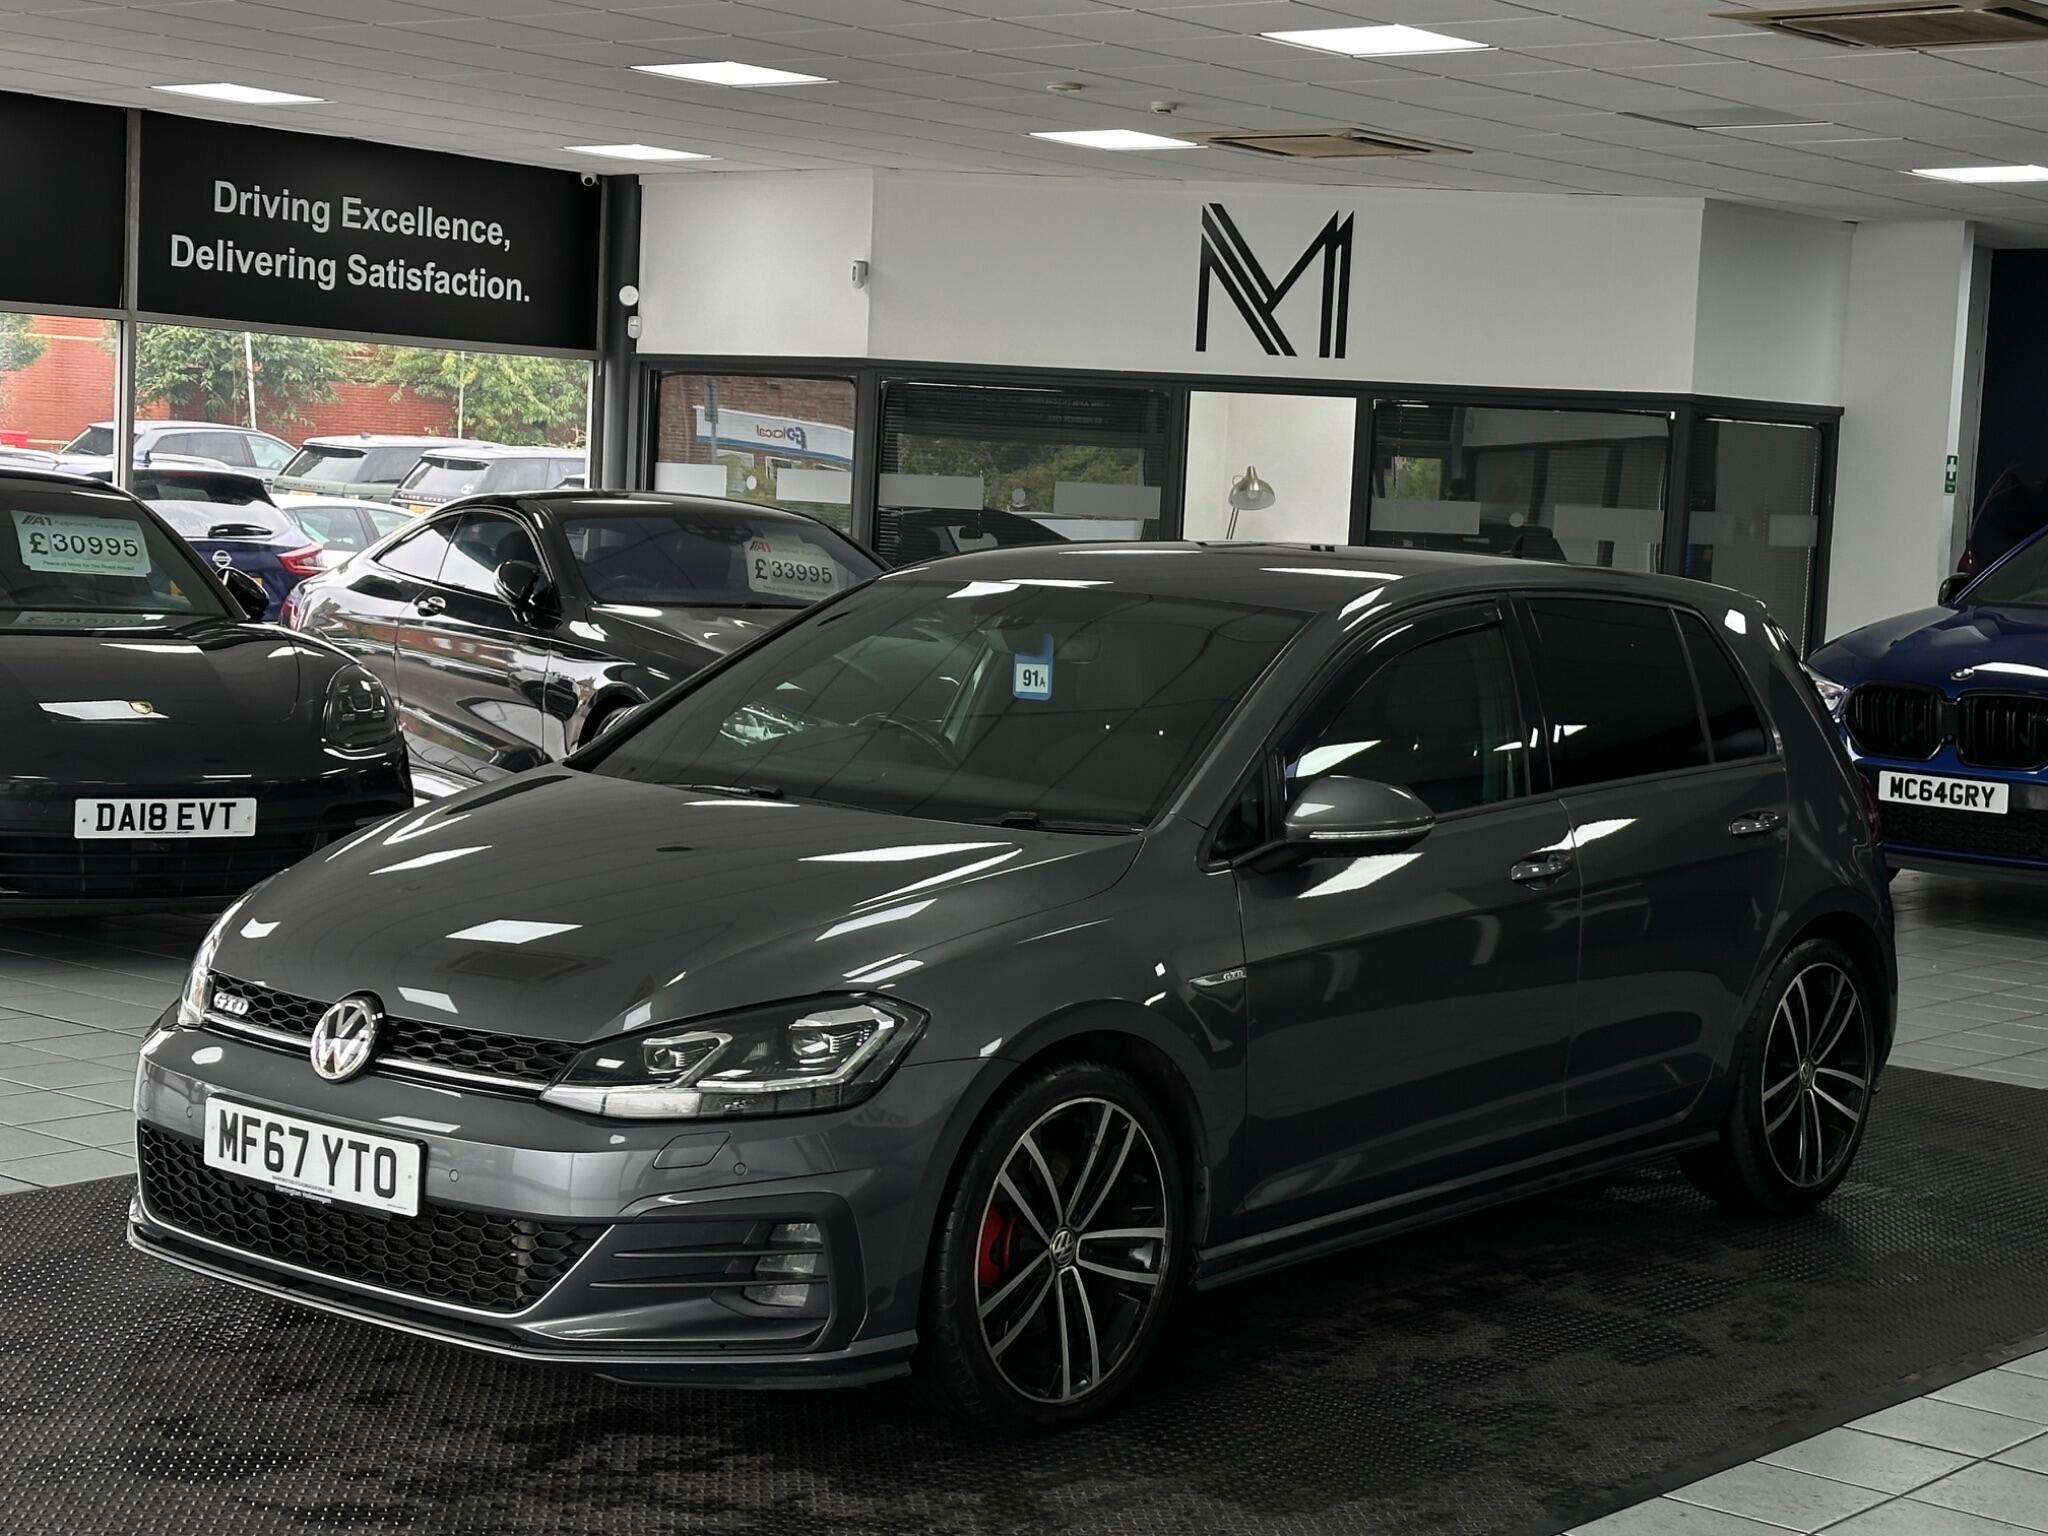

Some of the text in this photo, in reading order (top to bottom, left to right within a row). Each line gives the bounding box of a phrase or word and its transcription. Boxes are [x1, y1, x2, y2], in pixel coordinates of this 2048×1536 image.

[214, 180, 511, 252] Driving Excellence,
[171, 234, 531, 303] Delivering Satisfaction.
[29, 532, 138, 557] £30995
[754, 558, 832, 584] £33995
[1889, 776, 1995, 808] MC64GRY
[96, 802, 237, 831] DA18 EVT
[218, 1108, 397, 1199] MF67 YTO
